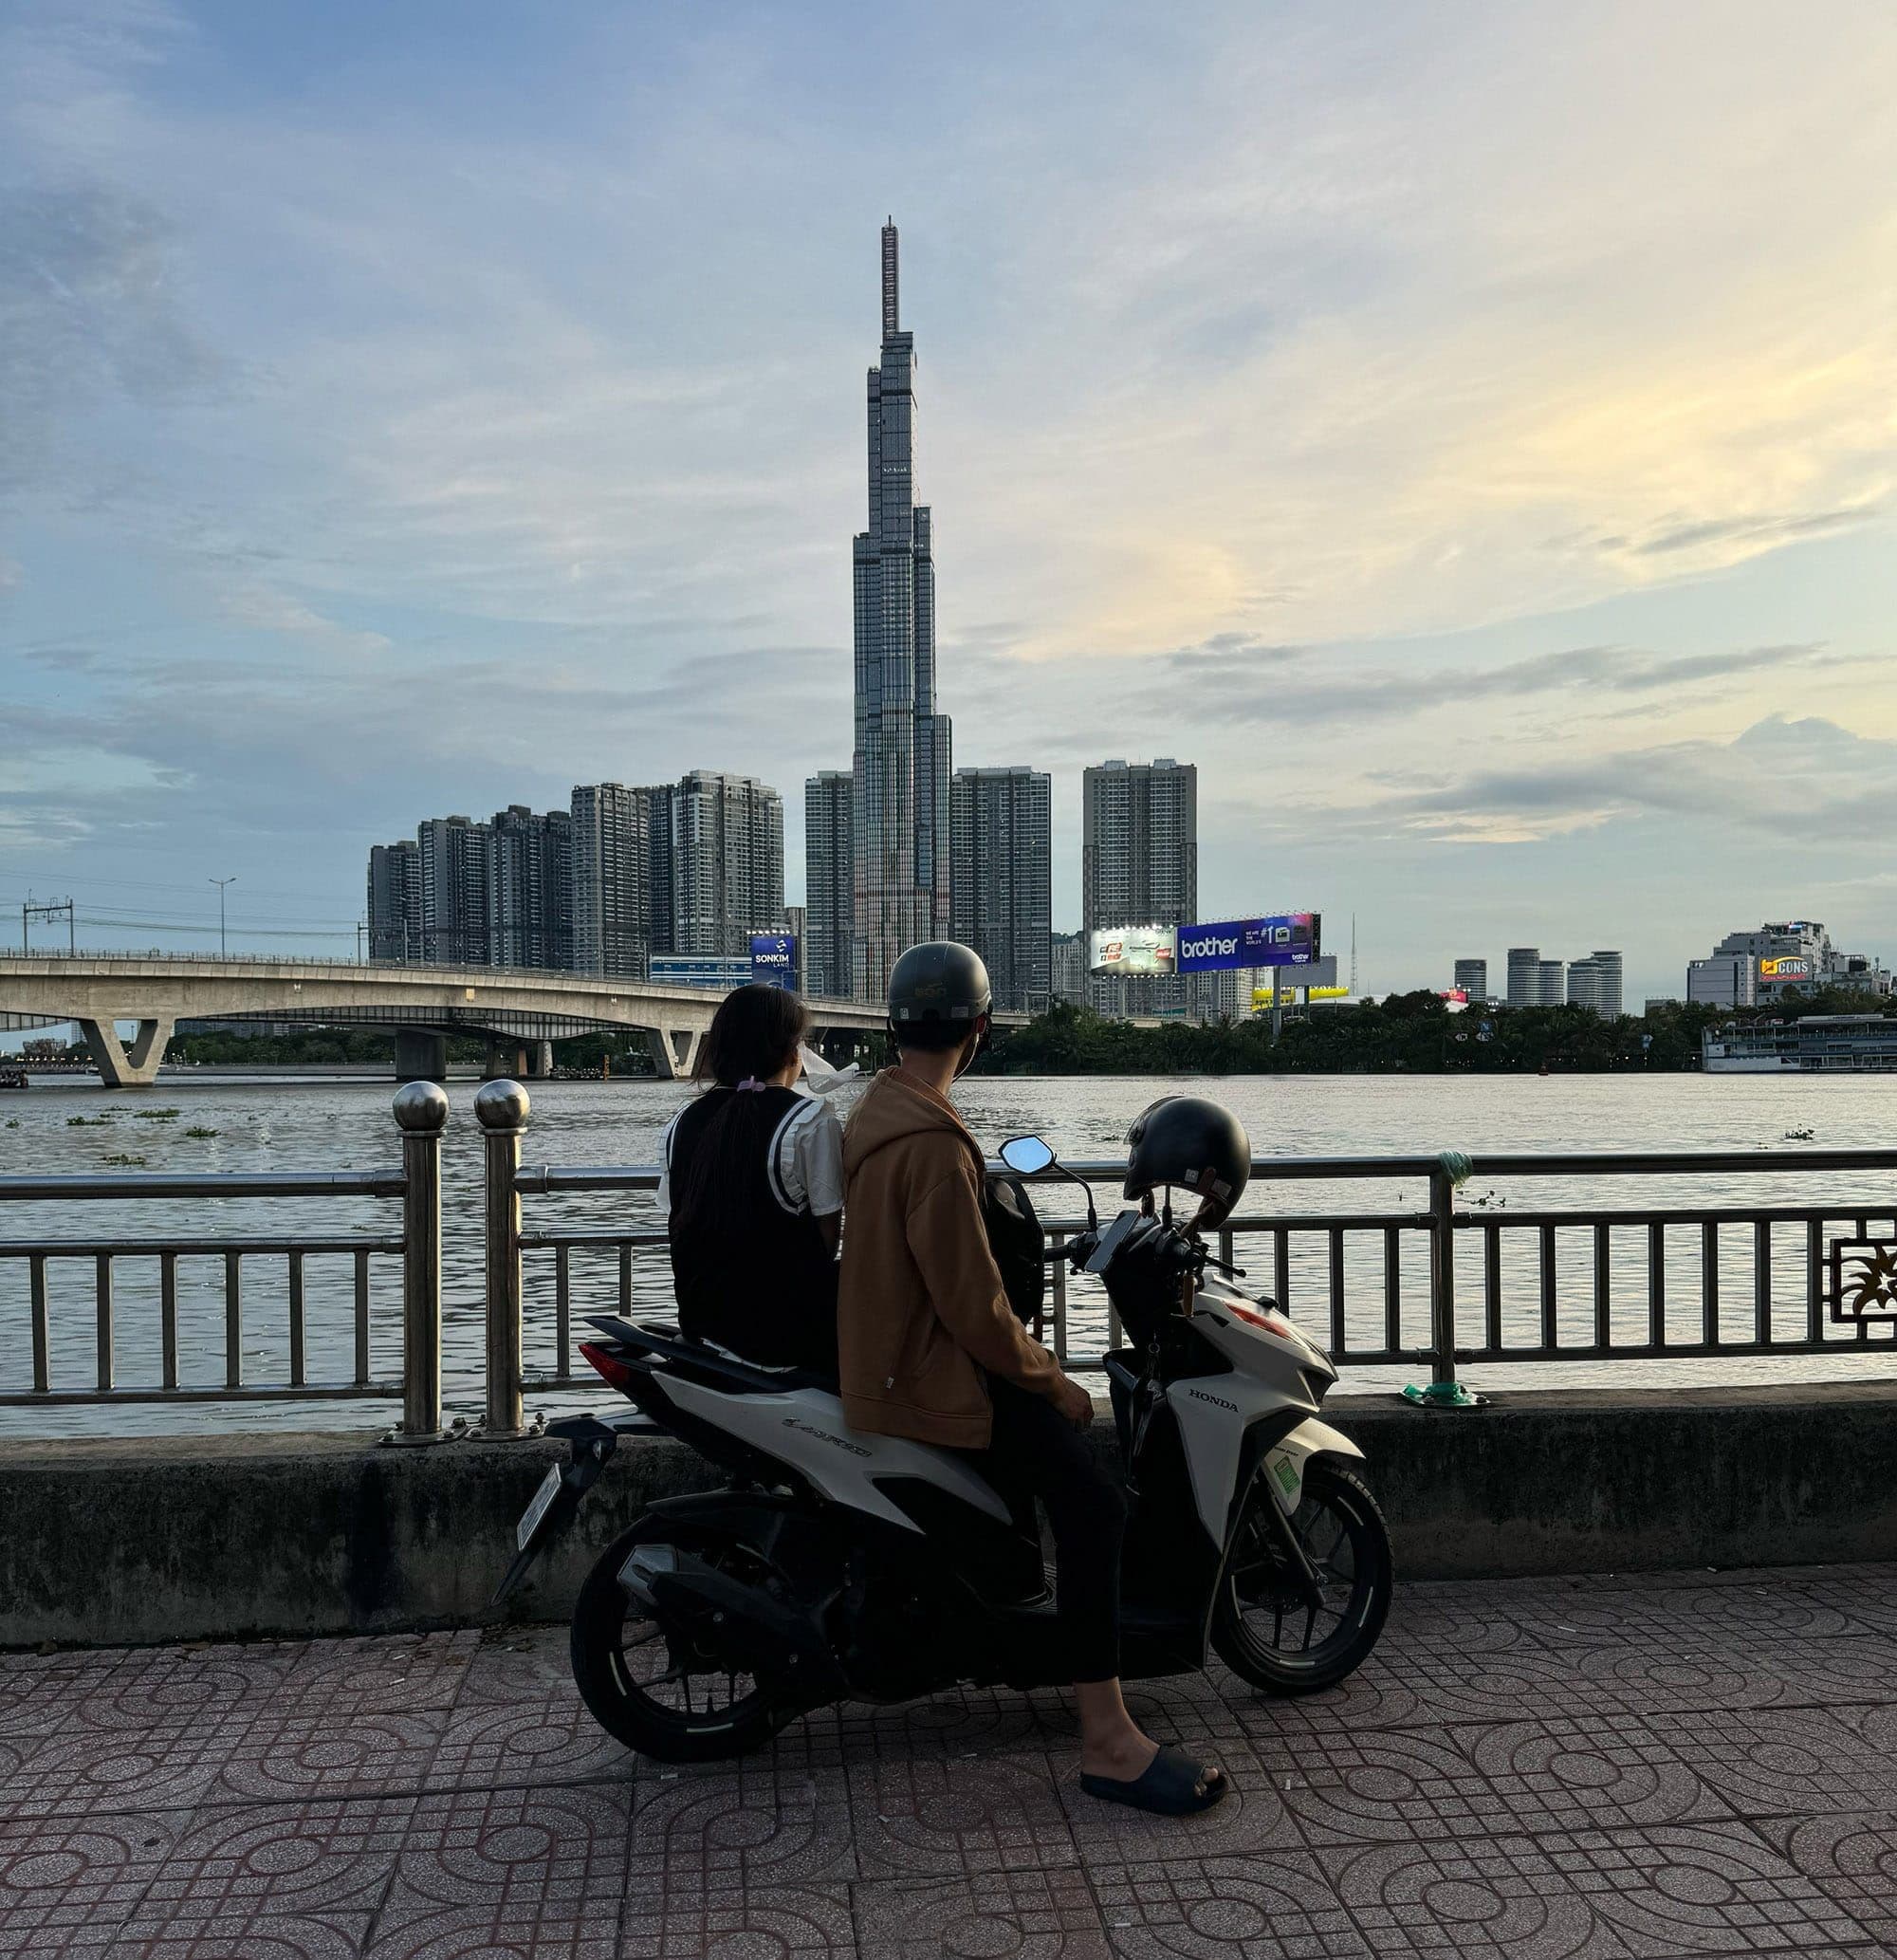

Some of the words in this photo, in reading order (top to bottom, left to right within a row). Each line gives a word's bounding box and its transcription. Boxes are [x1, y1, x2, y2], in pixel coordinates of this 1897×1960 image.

[1261, 926, 1274, 944] #1
[1182, 936, 1238, 958] brother
[756, 954, 789, 963] SONKIM
[1188, 1389, 1239, 1413] HONDA
